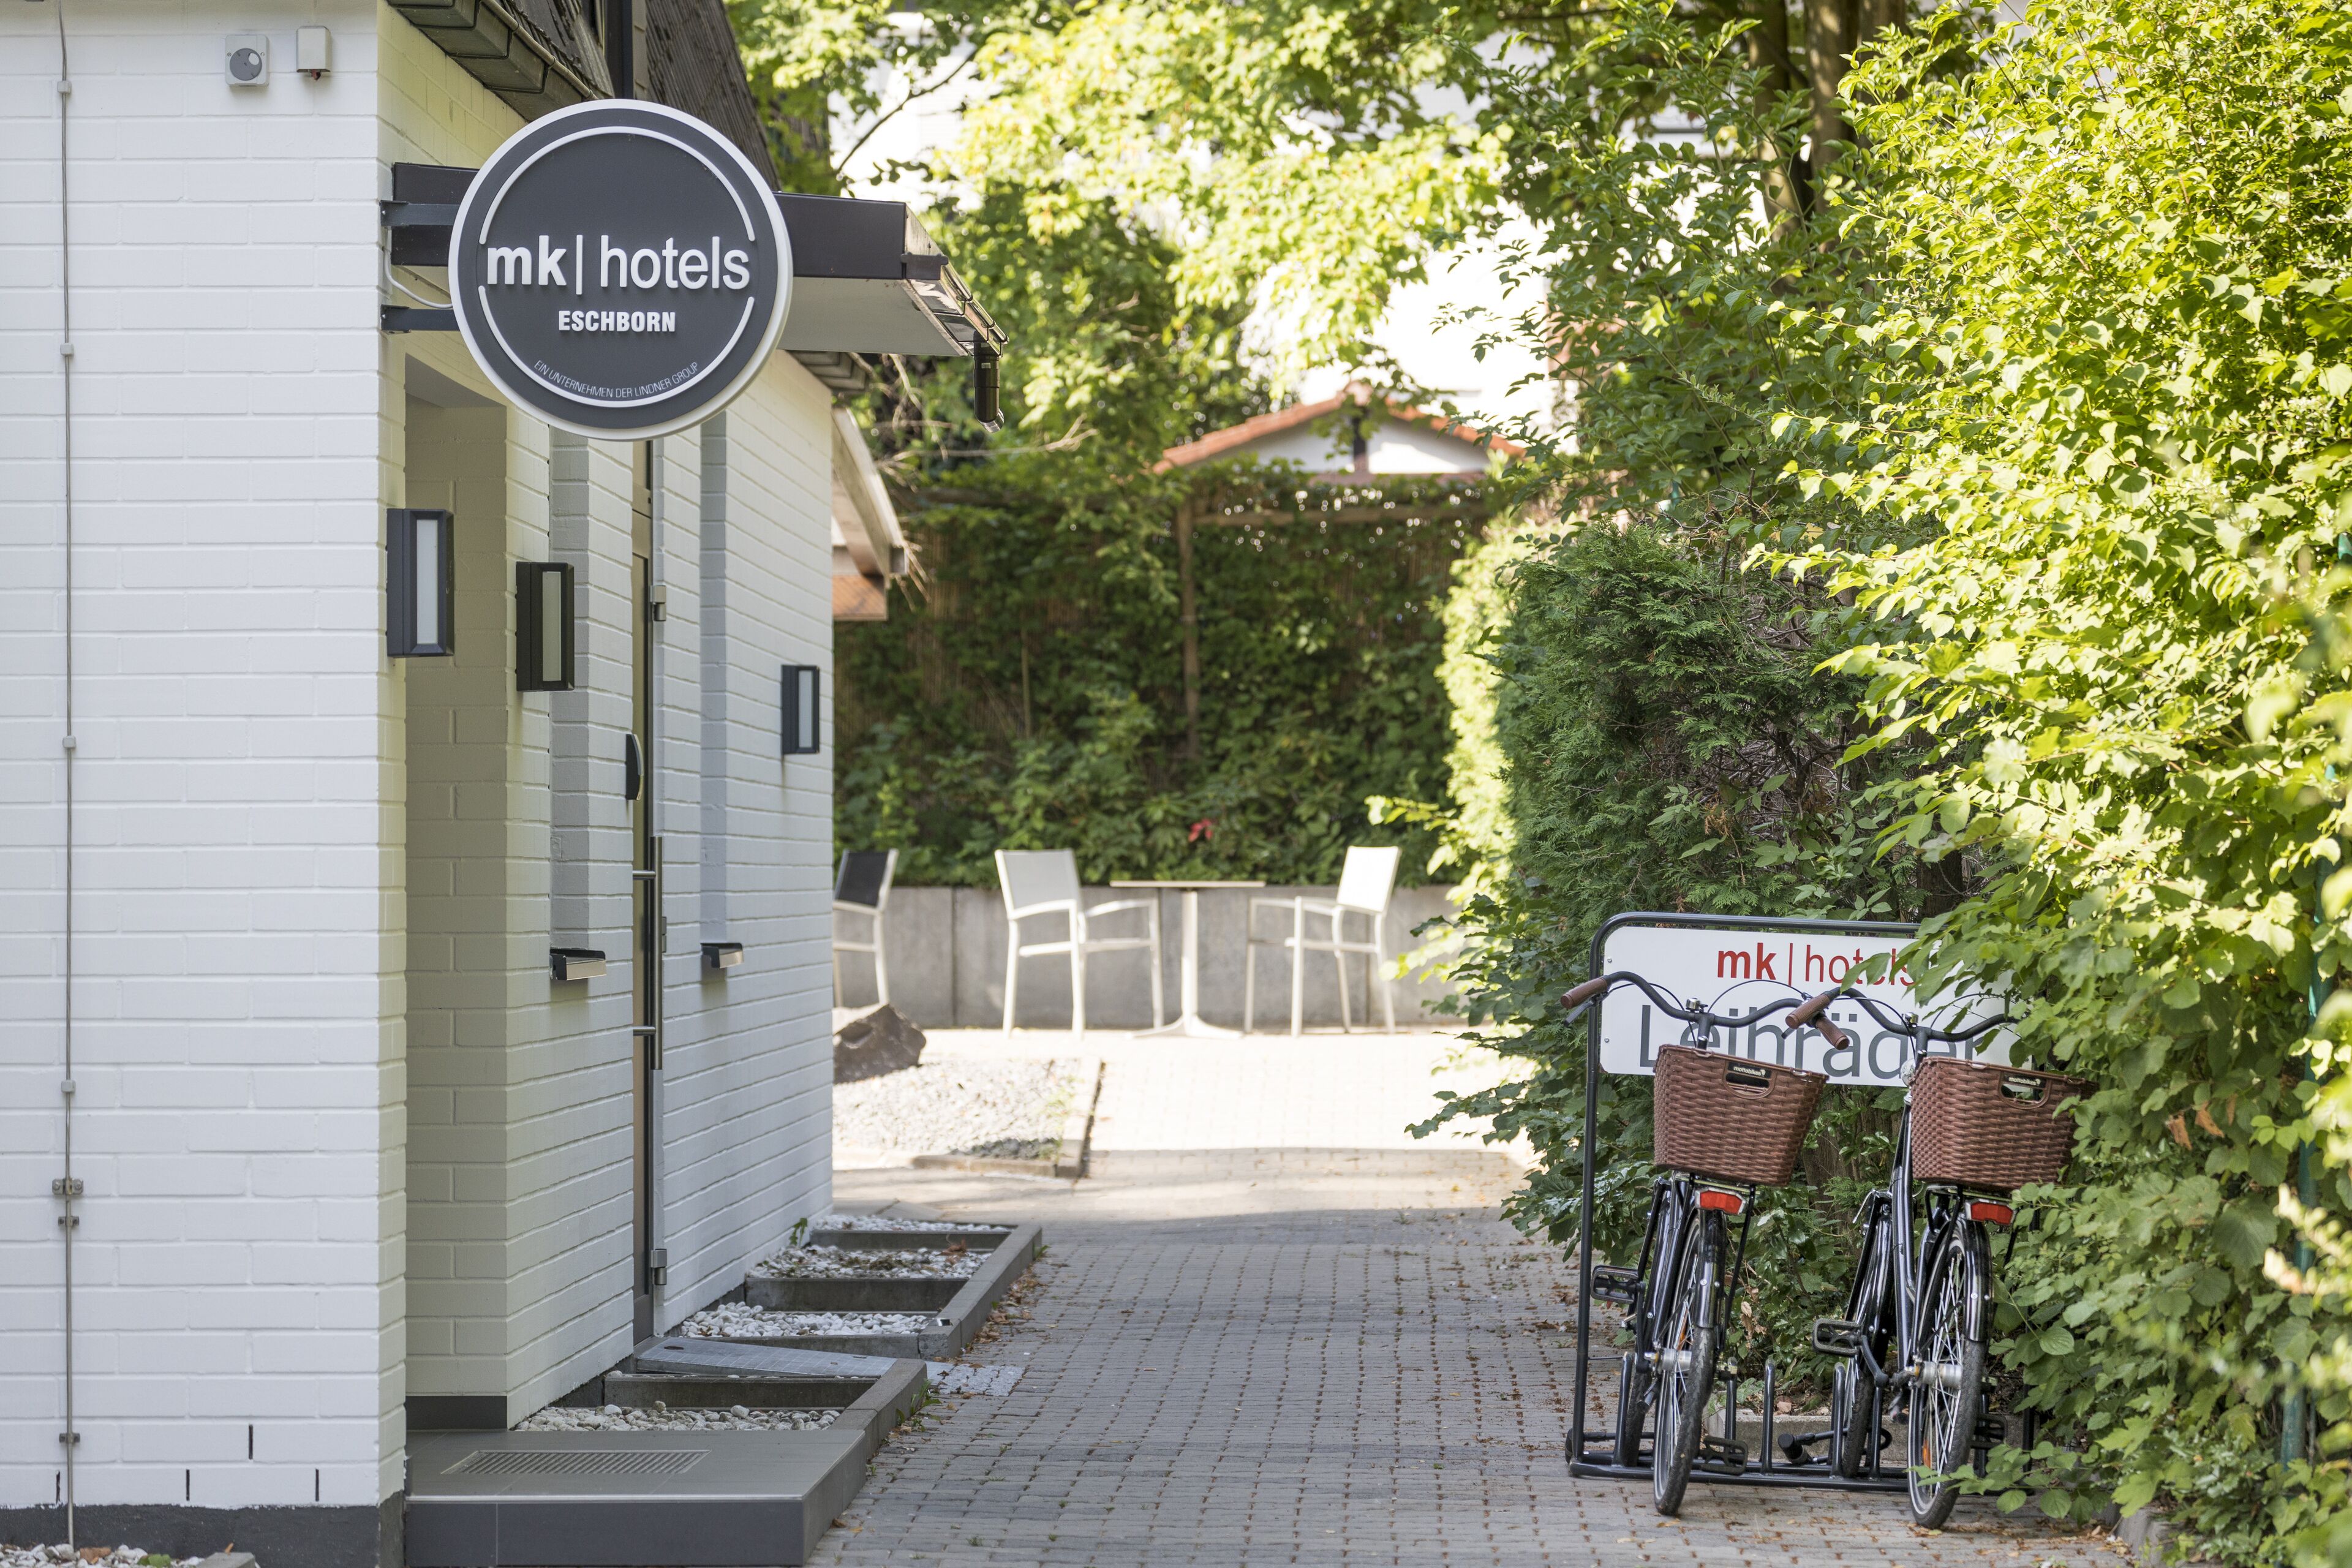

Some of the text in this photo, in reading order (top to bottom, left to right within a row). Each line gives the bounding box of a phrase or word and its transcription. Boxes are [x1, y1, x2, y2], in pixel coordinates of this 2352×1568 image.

[558, 310, 676, 333] ESCHBORN
[533, 360, 699, 398] EIN UNTERNEHMEN DER LINDNER GROUP
[1733, 1066, 1762, 1076] mottobikes
